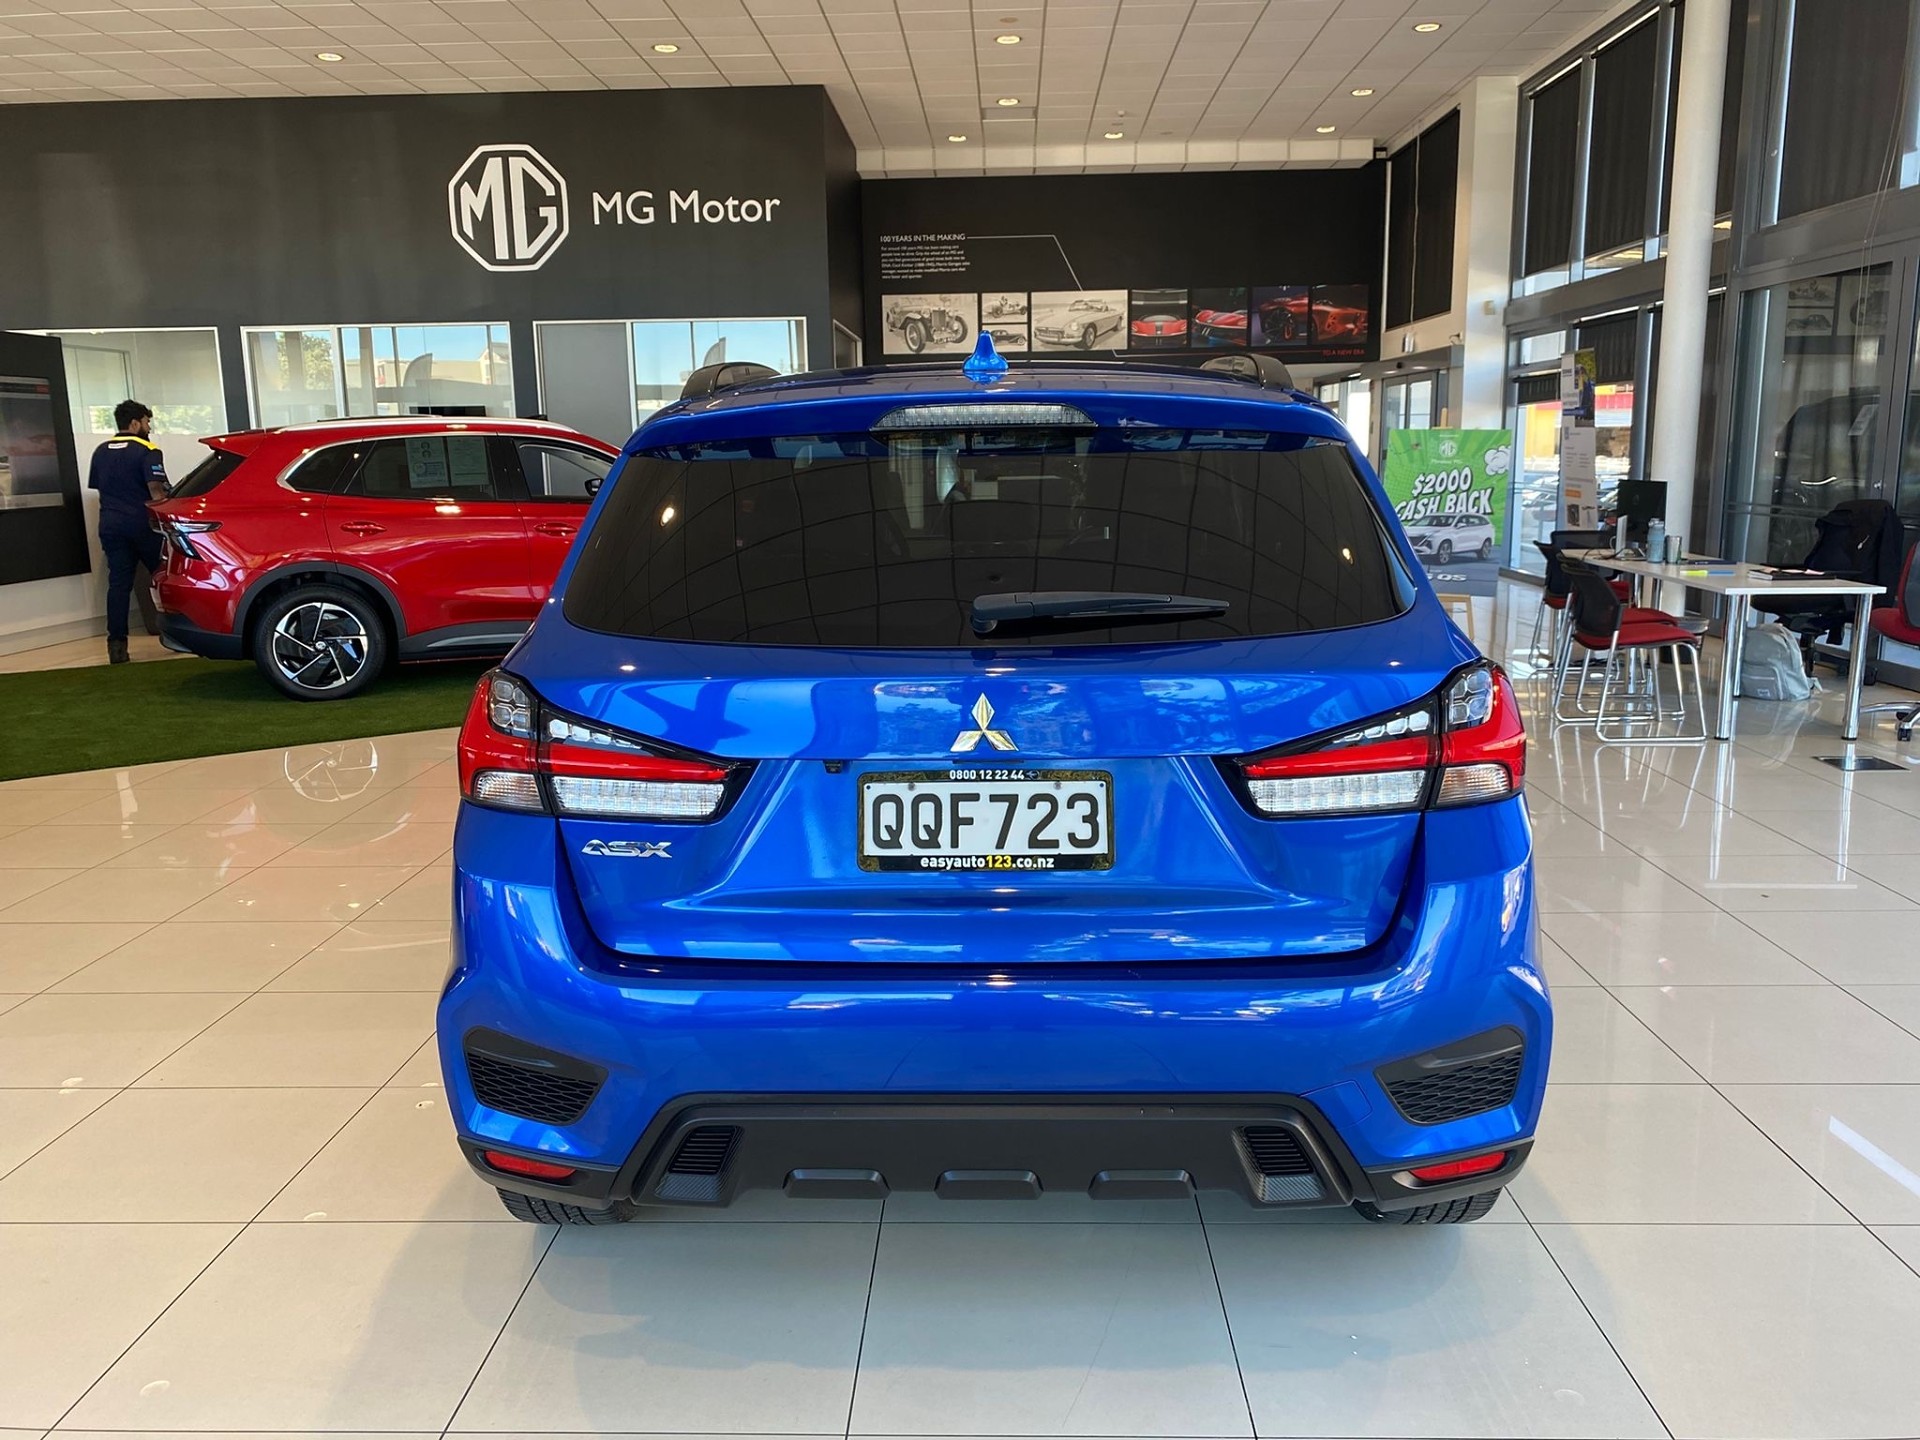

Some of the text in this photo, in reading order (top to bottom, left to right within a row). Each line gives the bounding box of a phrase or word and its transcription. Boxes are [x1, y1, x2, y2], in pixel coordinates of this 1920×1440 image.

[459, 156, 558, 260] MG
[592, 189, 781, 225] MG Motor
[892, 234, 912, 242] YEARS
[913, 234, 922, 242] IN
[922, 233, 936, 241] THE
[936, 233, 966, 241] MAKING
[1411, 466, 1473, 498] $2000
[1395, 487, 1494, 521] CASH BACK
[949, 769, 1025, 780] 0800 12 22 44
[872, 793, 1101, 850] QQF723
[581, 839, 673, 859] ASX
[920, 855, 1055, 871] easyauto123.co.nz
